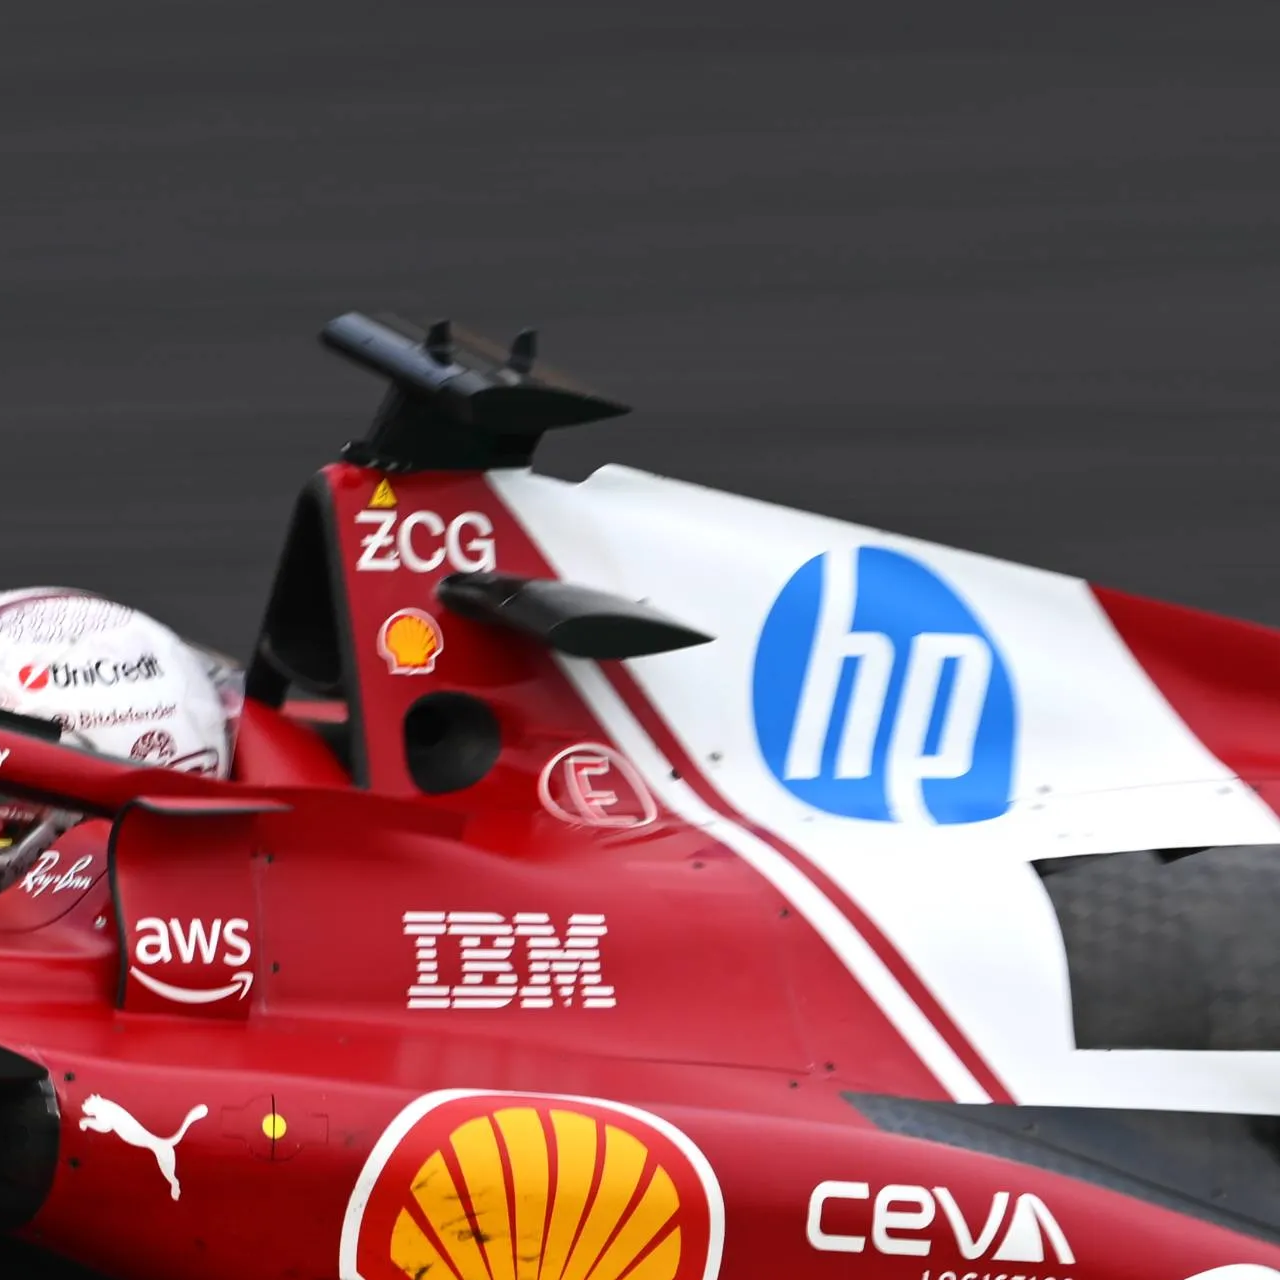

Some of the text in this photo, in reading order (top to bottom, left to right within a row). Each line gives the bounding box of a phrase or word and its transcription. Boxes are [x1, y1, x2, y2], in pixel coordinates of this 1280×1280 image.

[355, 509, 497, 574] ZCG
[50, 651, 164, 688] UniCredit
[784, 547, 993, 826] hp
[133, 916, 252, 966] aws
[403, 911, 616, 1008] IBM
